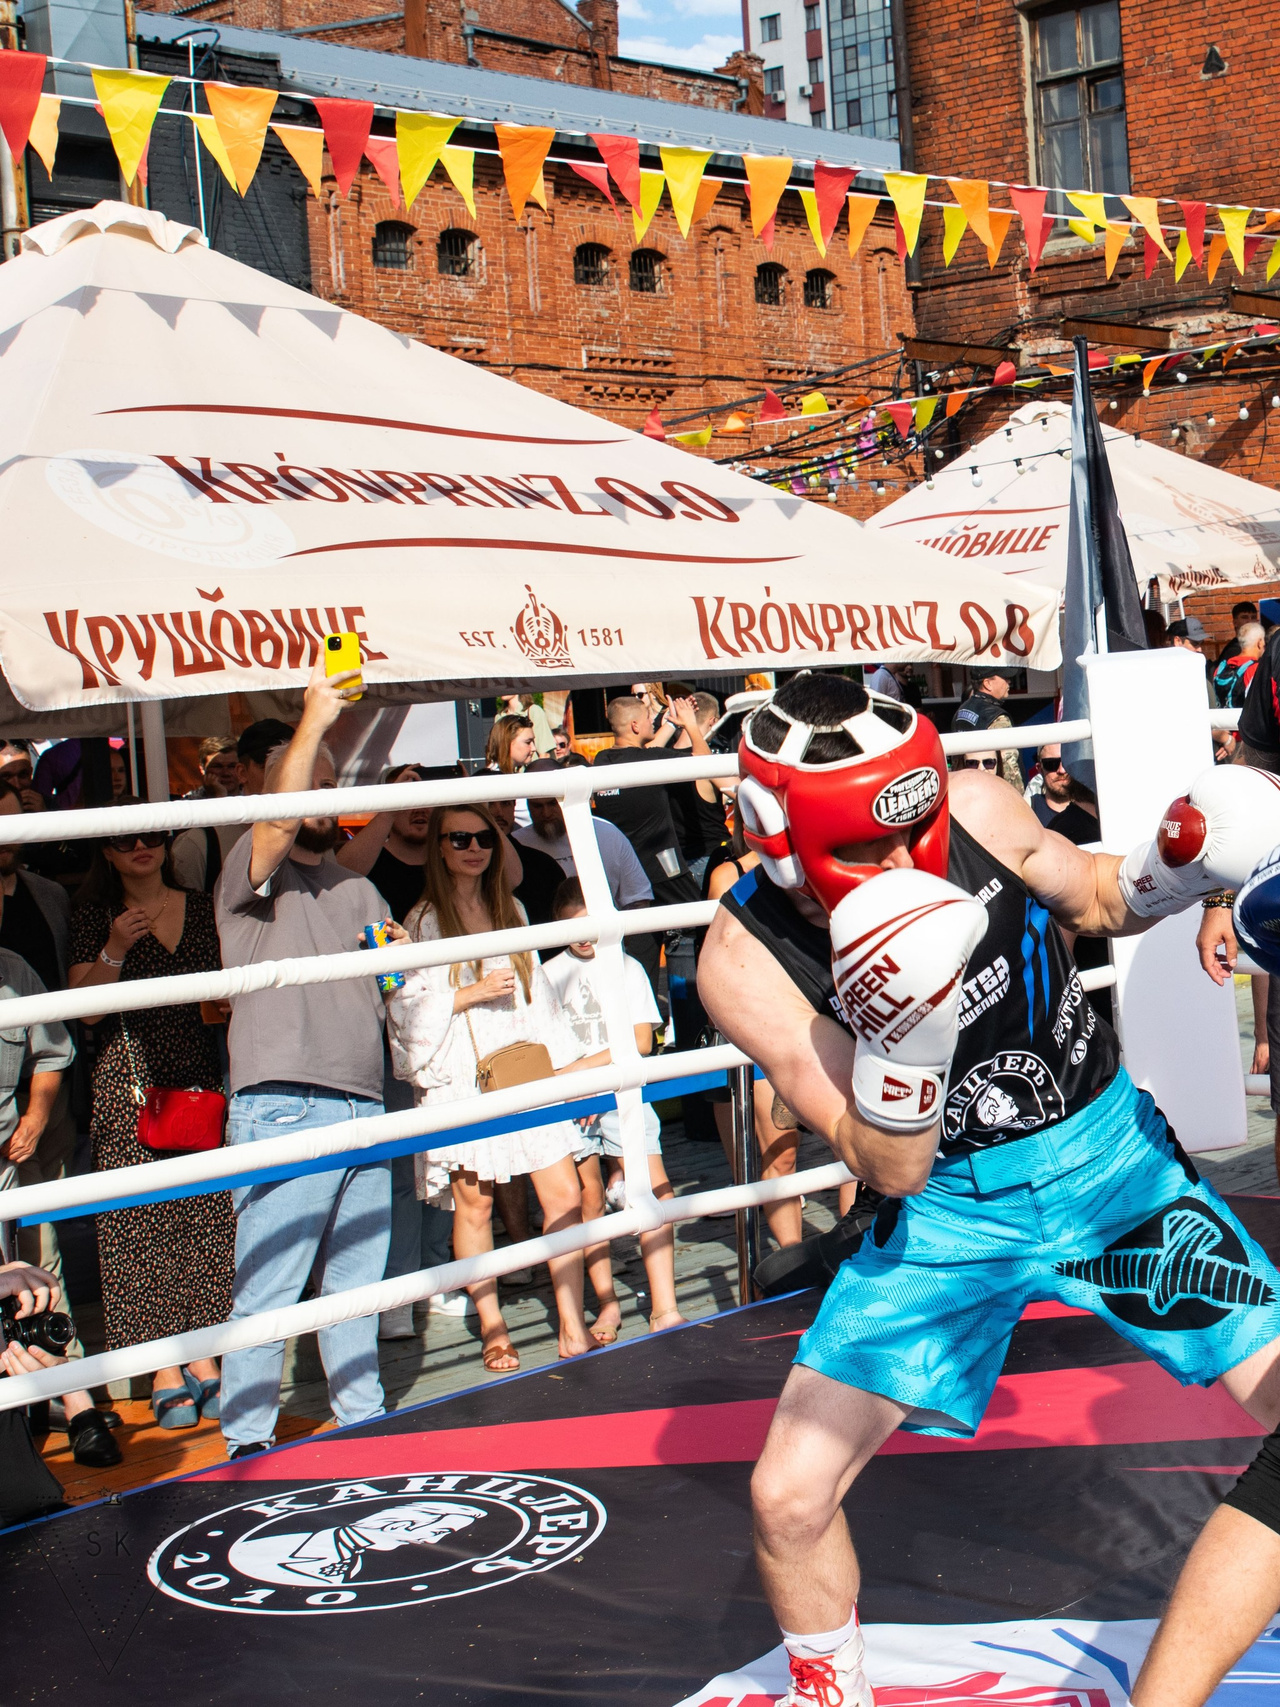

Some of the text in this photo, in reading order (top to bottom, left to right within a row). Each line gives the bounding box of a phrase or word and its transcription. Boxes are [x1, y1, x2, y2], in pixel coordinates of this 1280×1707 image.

[459, 628, 624, 649] EST. 1581
[879, 772, 939, 820] LEADERS
[895, 809, 917, 823] FIGHT
[1136, 883, 1157, 895] HILL
[957, 955, 1010, 1013] ИТВА
[850, 990, 916, 1043] HILL
[242, 1475, 590, 1574] КАНЦЛЕРЪ
[174, 1552, 358, 1606] 2010
